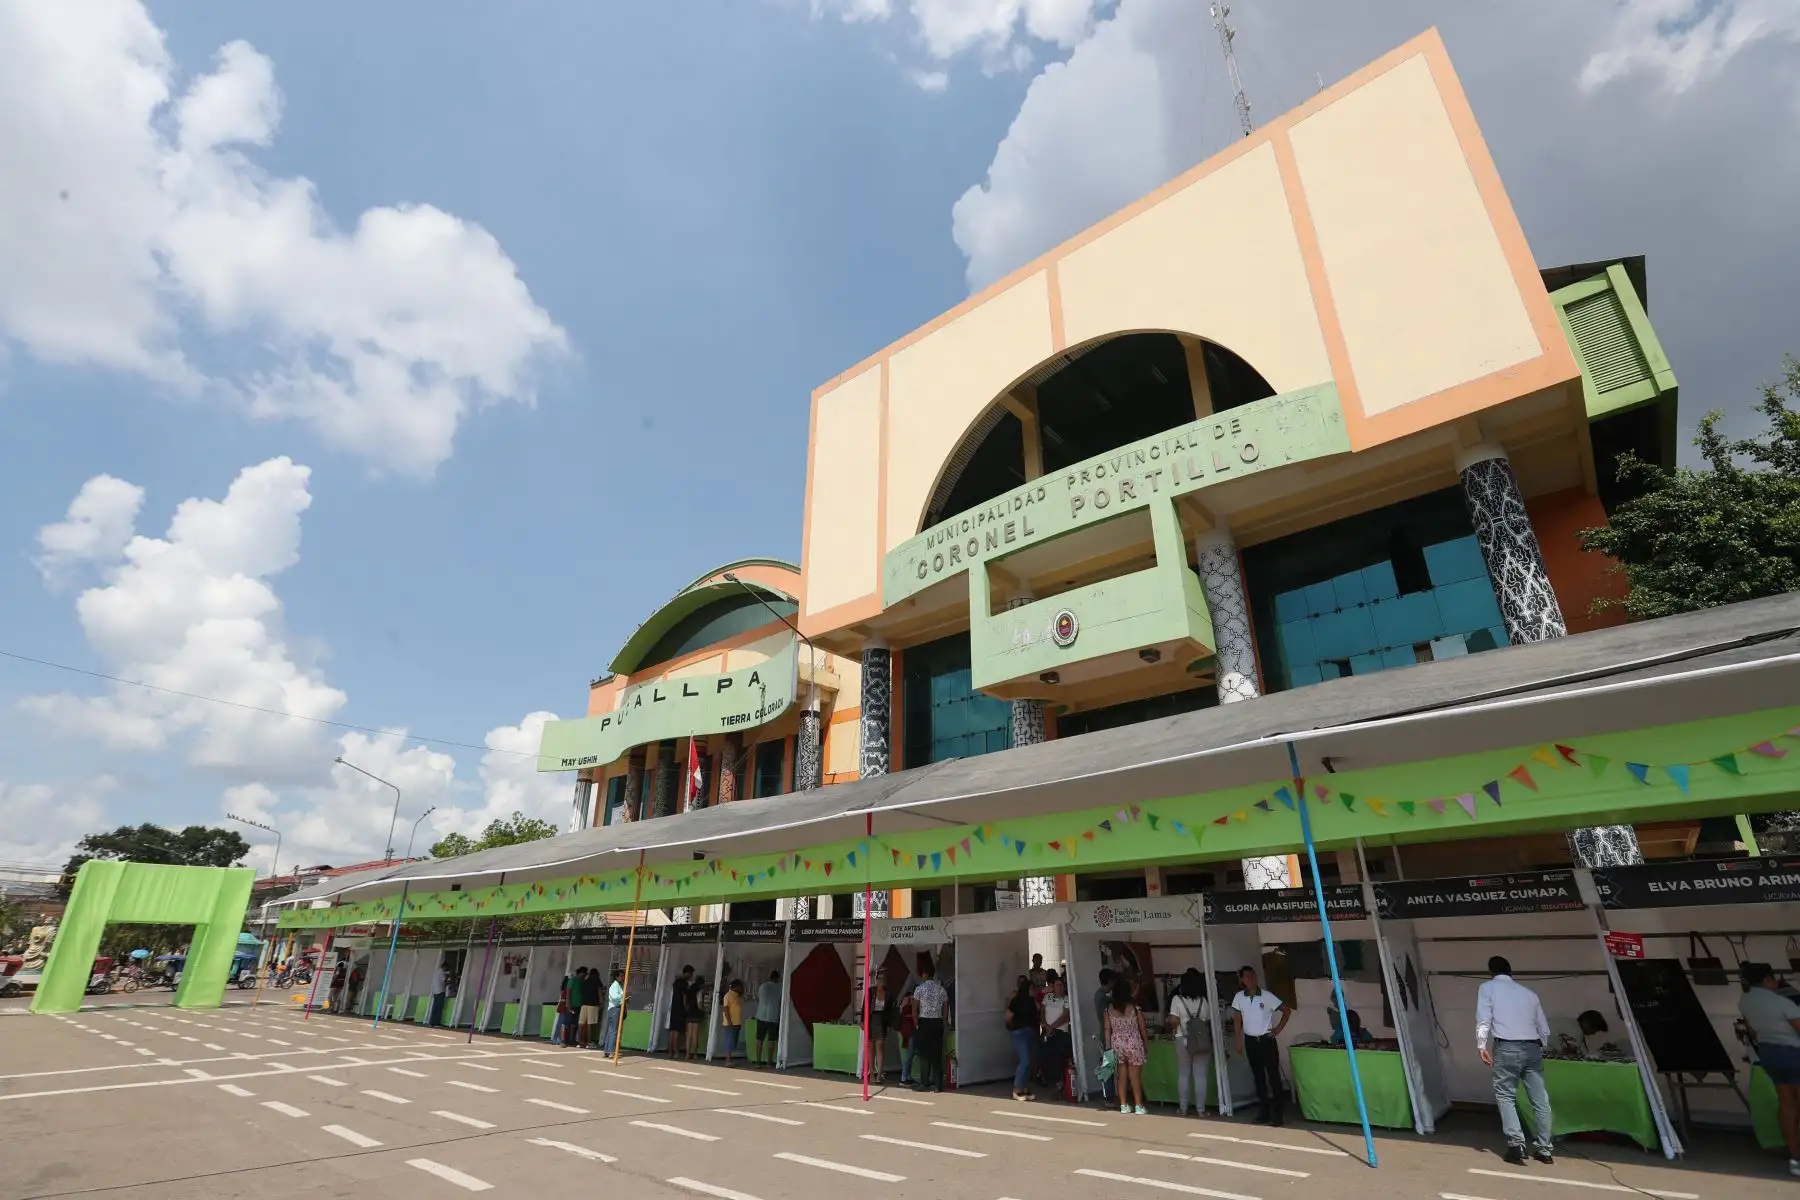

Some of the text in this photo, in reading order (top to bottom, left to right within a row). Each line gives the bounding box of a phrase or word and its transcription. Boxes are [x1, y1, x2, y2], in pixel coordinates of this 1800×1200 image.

[926, 418, 1242, 550] MUNICIPALIDAD PROVINCIAL DE
[917, 440, 1260, 580] CORONEL PORTILLO
[720, 713, 751, 727] TIERRA
[561, 755, 598, 767] MAY USHIN
[1648, 879, 1691, 892] ELVA
[1693, 876, 1753, 890] BRUNO
[1407, 886, 1569, 905] ANITA VASQUEZ CUMAPA
[1143, 910, 1171, 919] Lamas
[1225, 903, 1260, 913] GLORIA
